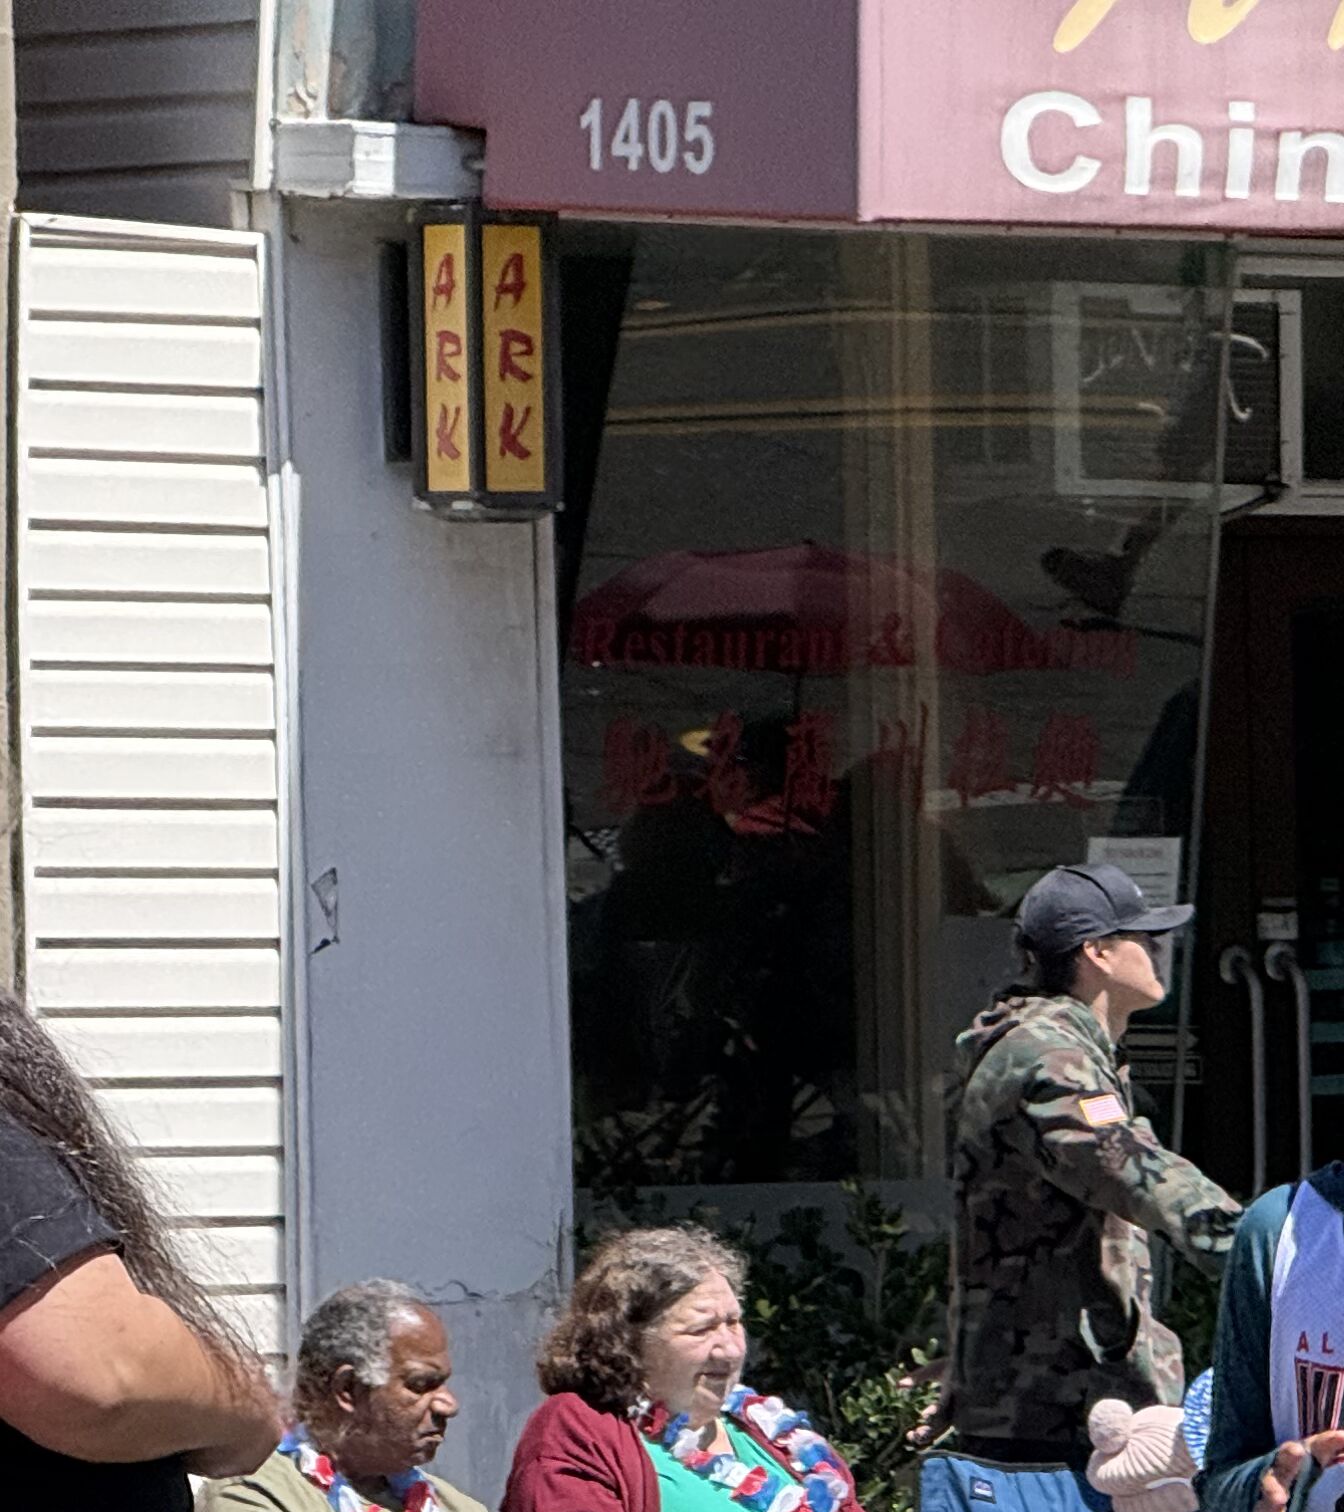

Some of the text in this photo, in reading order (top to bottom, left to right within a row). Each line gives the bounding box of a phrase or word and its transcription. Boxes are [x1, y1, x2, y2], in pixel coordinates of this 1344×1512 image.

[579, 97, 717, 175] 1405
[431, 251, 463, 461] ARK
[494, 251, 535, 462] ARK
